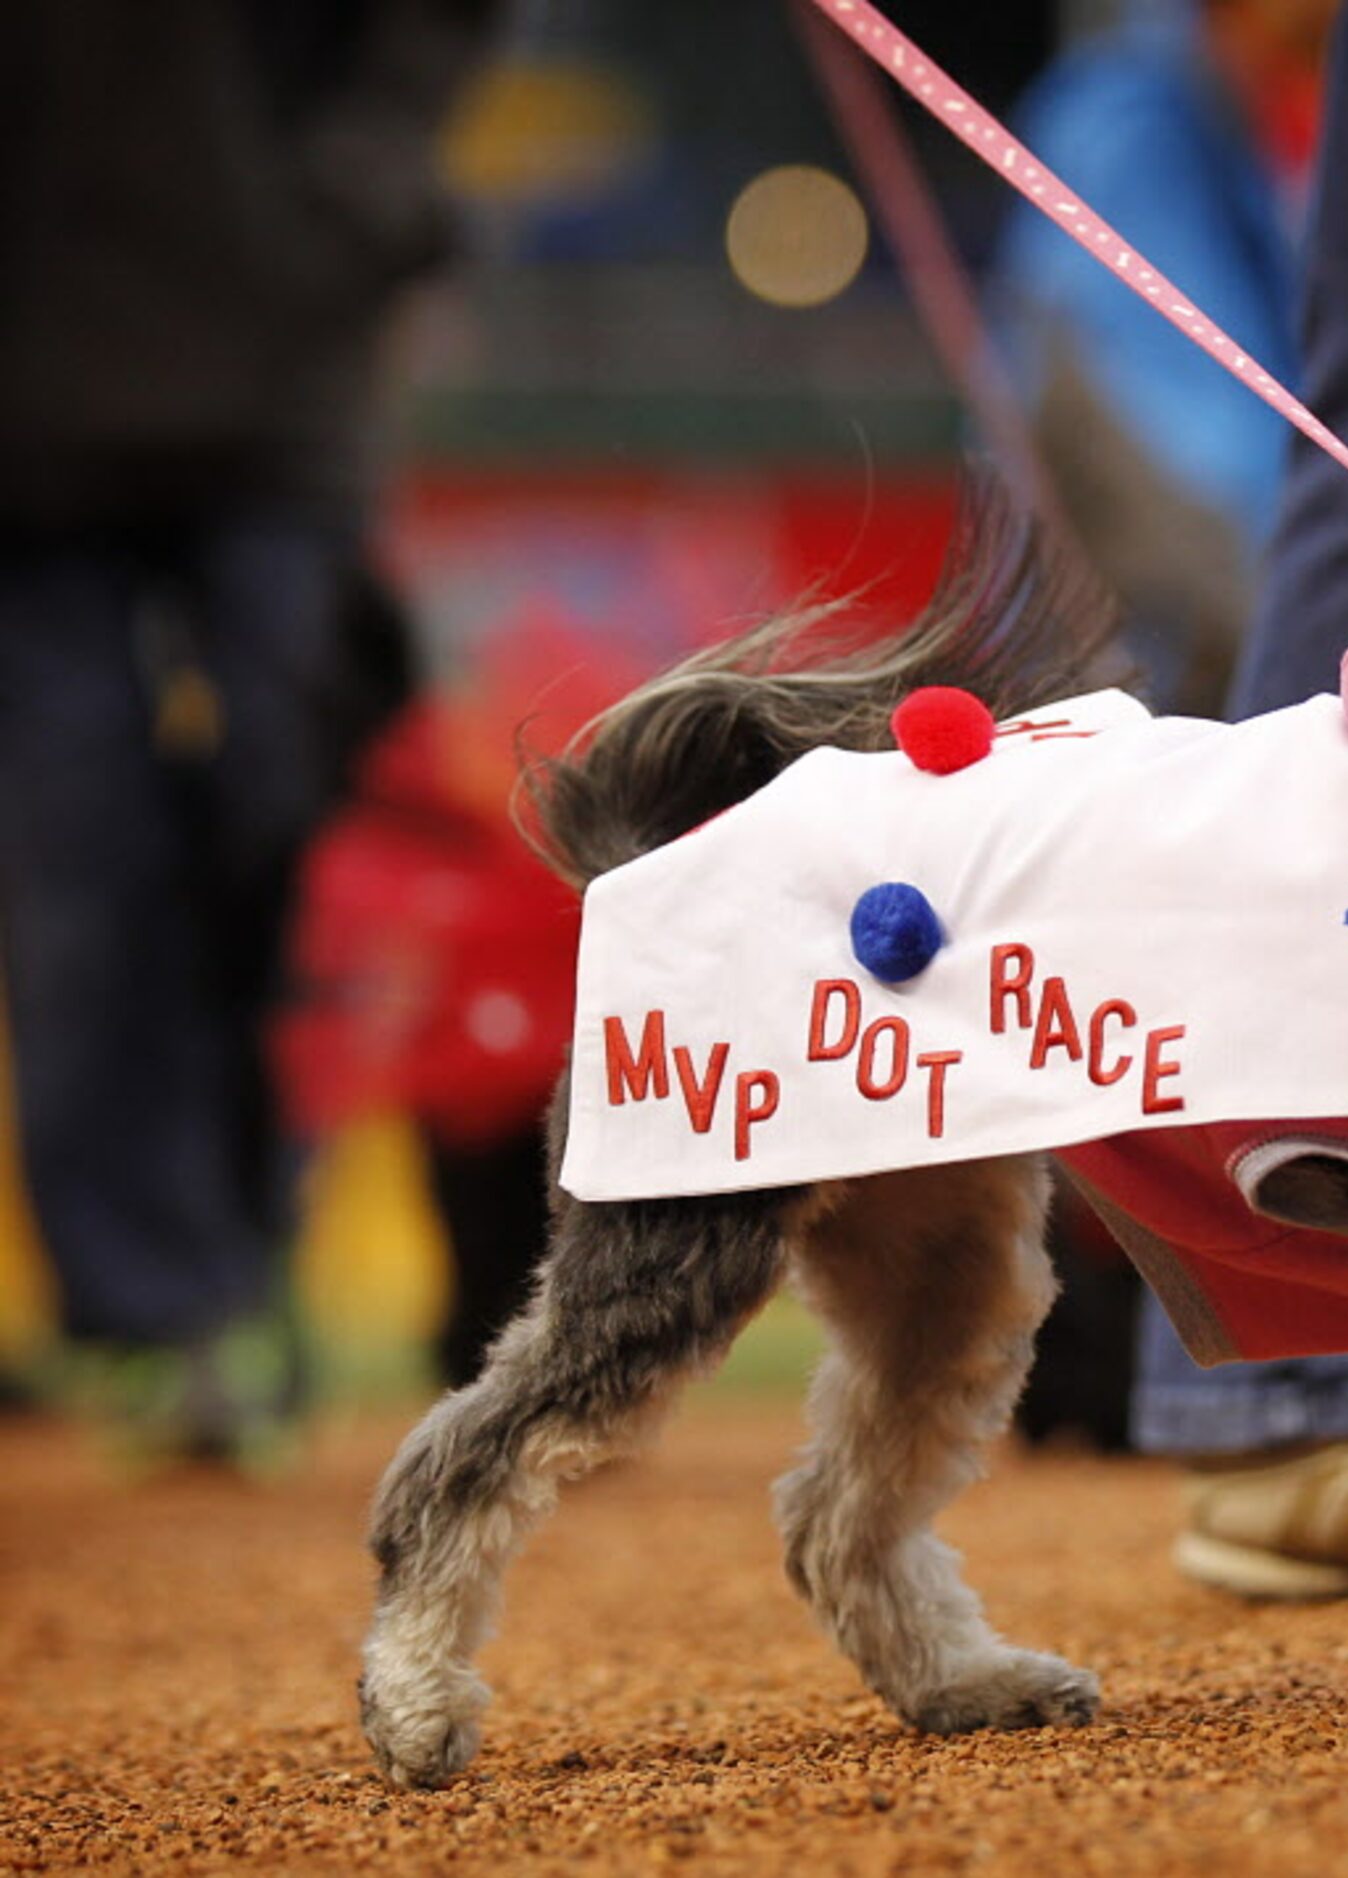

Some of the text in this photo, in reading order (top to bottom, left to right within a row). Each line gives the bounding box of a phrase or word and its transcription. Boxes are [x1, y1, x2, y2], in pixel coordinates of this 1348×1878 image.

[603, 942, 1186, 1161] MVP DOT RACE
